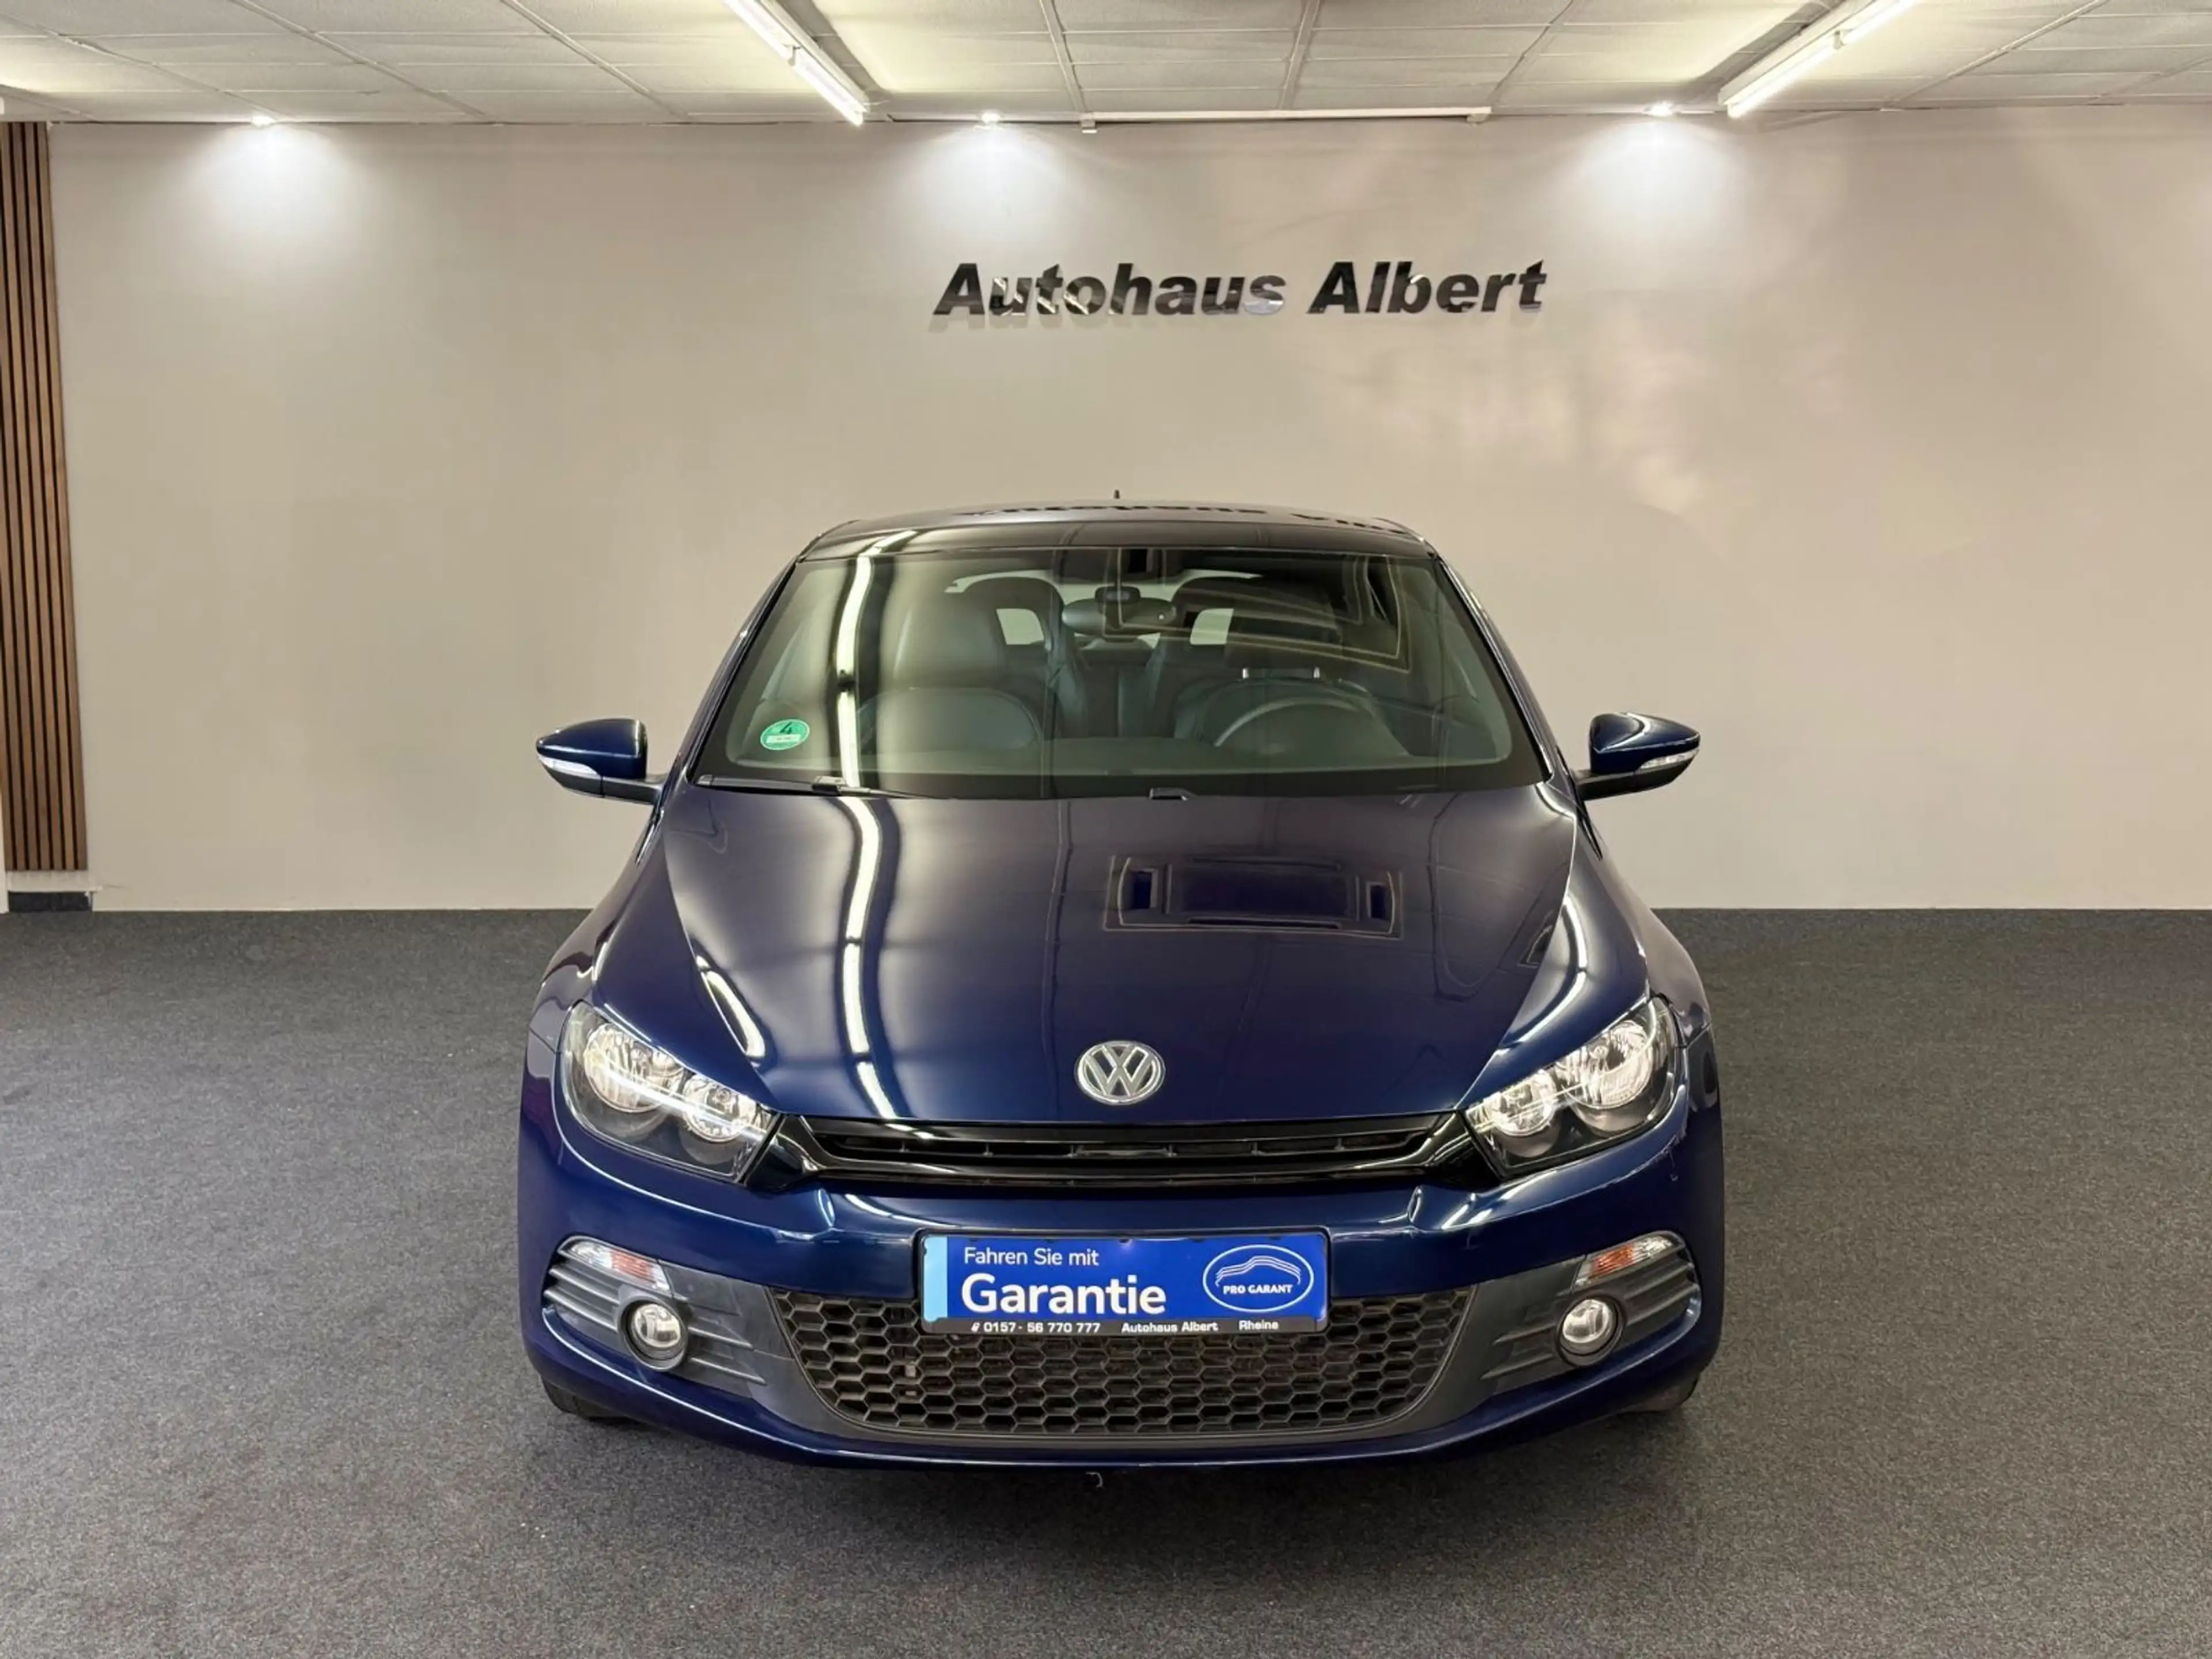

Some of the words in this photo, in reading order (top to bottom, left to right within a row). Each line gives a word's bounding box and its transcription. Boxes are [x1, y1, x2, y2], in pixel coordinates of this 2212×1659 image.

[933, 263, 1286, 315] Autohaus
[1305, 259, 1547, 315] Albert
[779, 721, 793, 734] 4
[1078, 1042, 1162, 1103] VW
[964, 1247, 1028, 1264] Fahren
[1033, 1248, 1063, 1266] Sie
[1068, 1248, 1100, 1266] mit
[961, 1272, 1166, 1315] Garantie
[1223, 1285, 1245, 1295] PRO
[1248, 1284, 1293, 1294] GARANT
[1027, 1322, 1043, 1333] 56
[1048, 1323, 1072, 1333] 770
[1076, 1323, 1101, 1333] 777
[1121, 1323, 1178, 1333] Autohaus
[1181, 1321, 1219, 1332] Albert
[1239, 1320, 1279, 1330] Rheine
